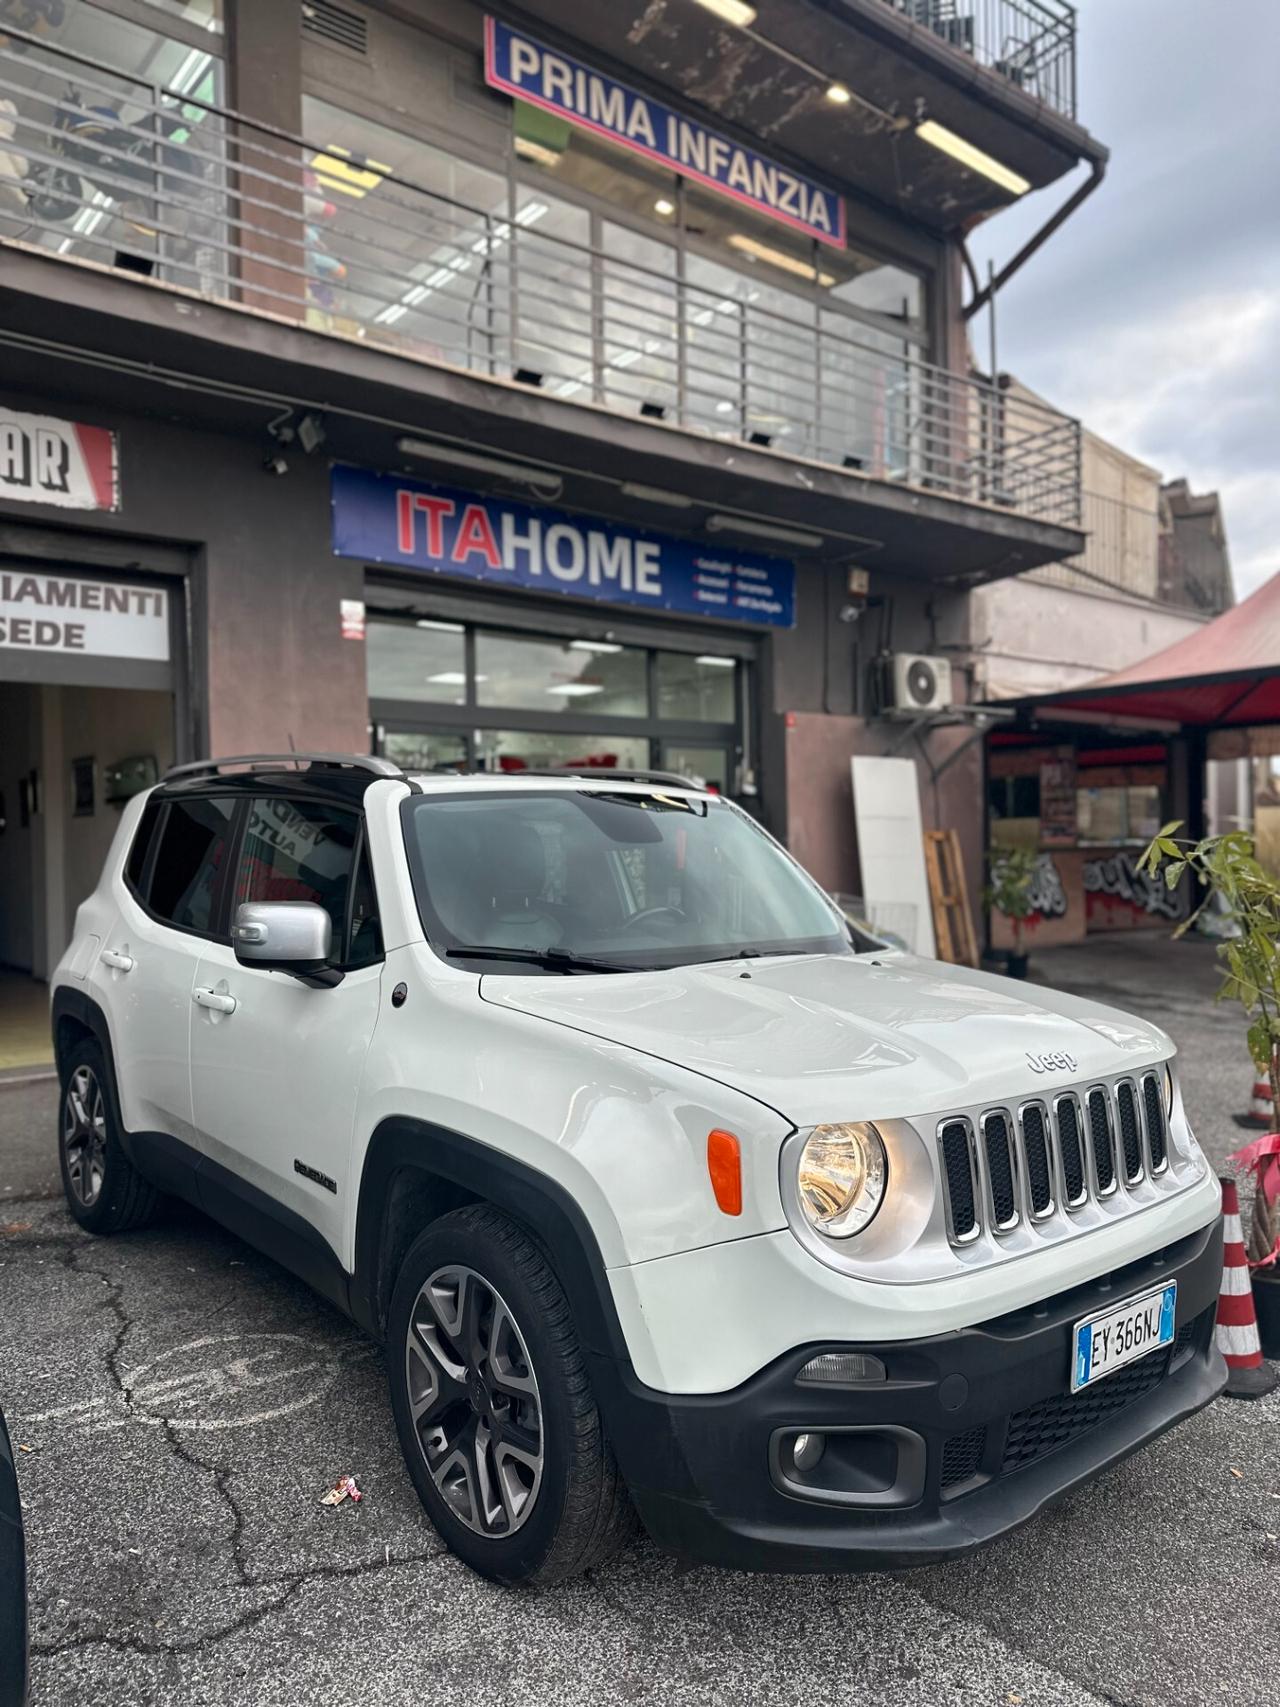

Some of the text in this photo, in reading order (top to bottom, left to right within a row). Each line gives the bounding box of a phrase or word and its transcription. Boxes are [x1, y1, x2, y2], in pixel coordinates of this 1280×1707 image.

[510, 37, 832, 232] PRIMA INFANZIA
[397, 489, 662, 595] ITAHOME
[1025, 1051, 1077, 1074] Jeep
